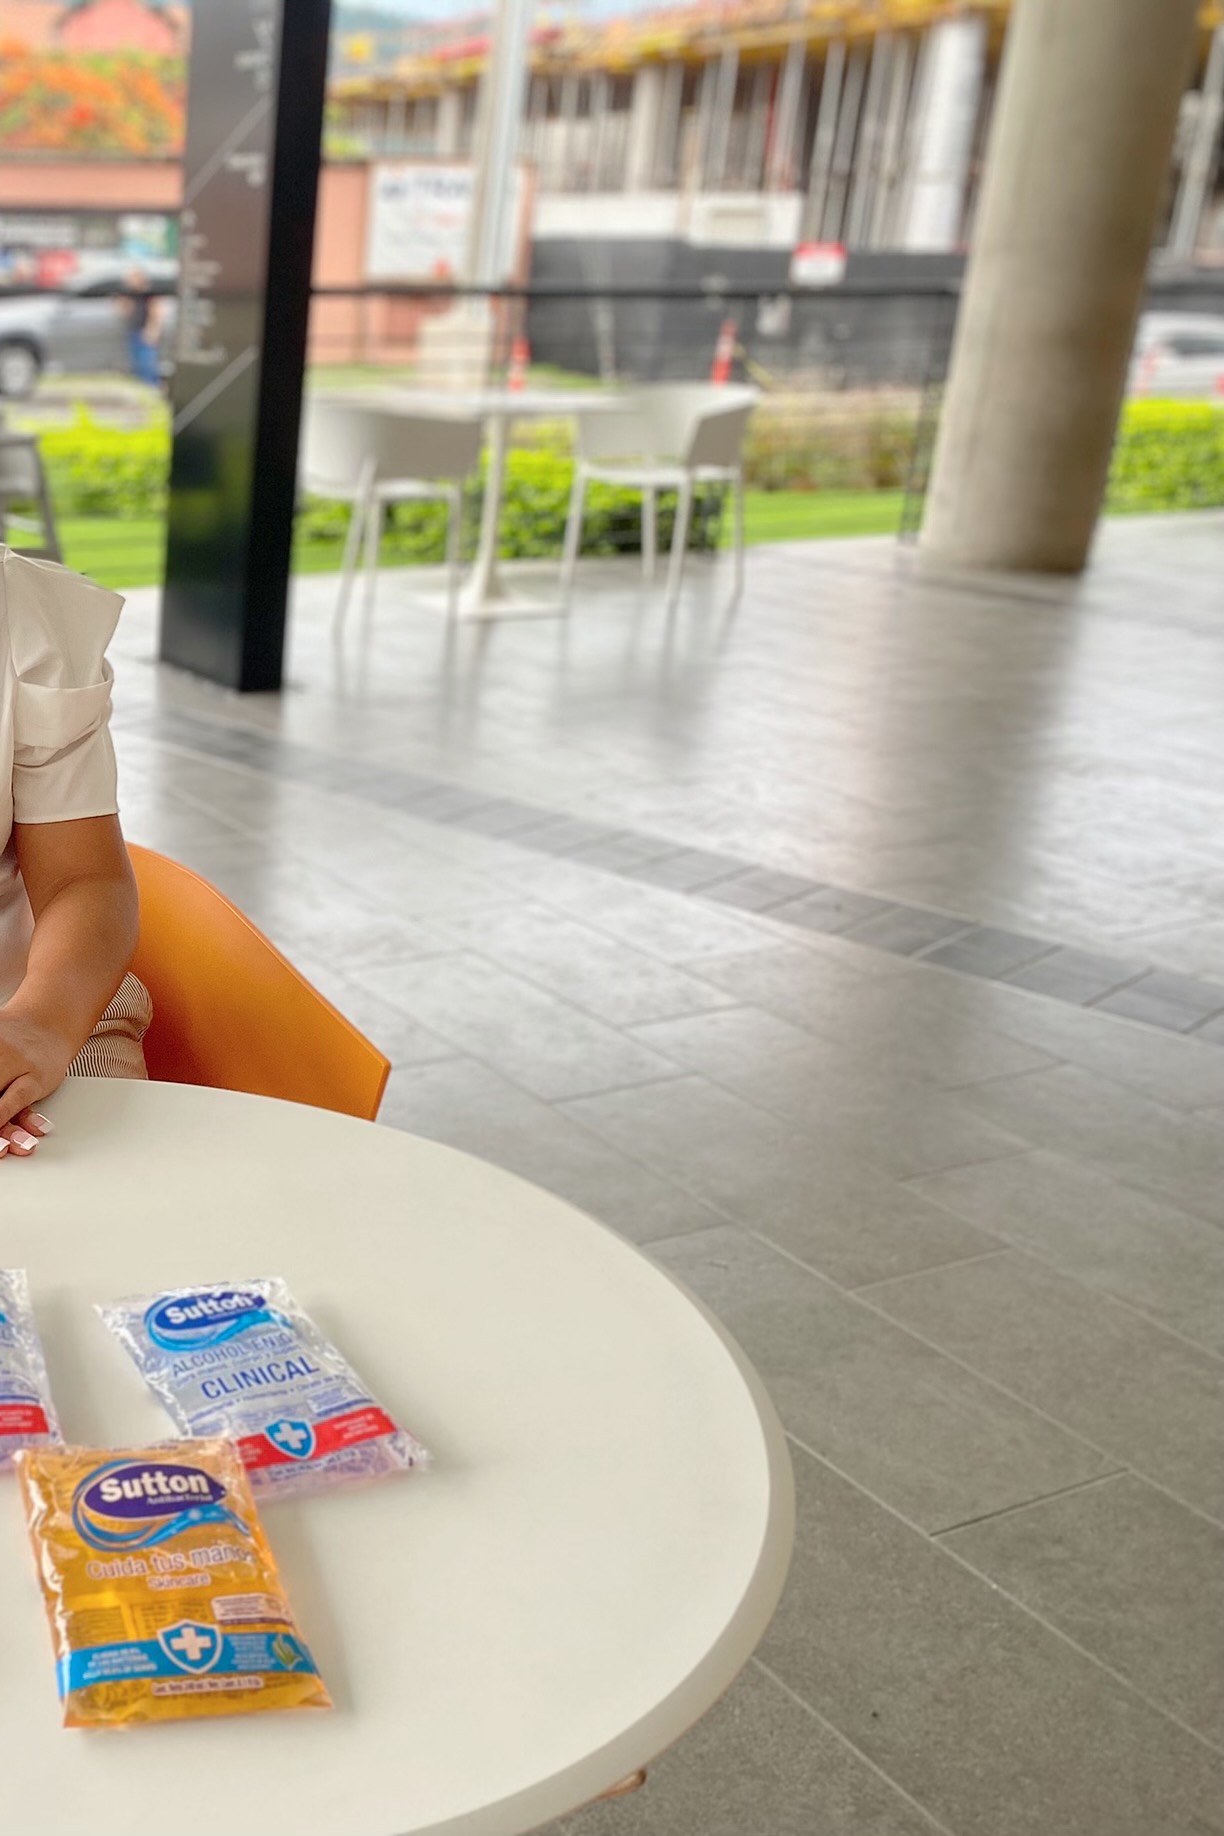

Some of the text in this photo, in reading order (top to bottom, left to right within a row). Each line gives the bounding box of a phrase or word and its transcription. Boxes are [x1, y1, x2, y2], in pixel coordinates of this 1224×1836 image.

[165, 1295, 254, 1324] Sutton
[172, 1343, 247, 1377] ALCOHOL
[200, 1356, 320, 1399] CLINICAL
[100, 1471, 210, 1502] Sutton
[87, 1558, 146, 1579] Cuida
[152, 1554, 184, 1572] tus
